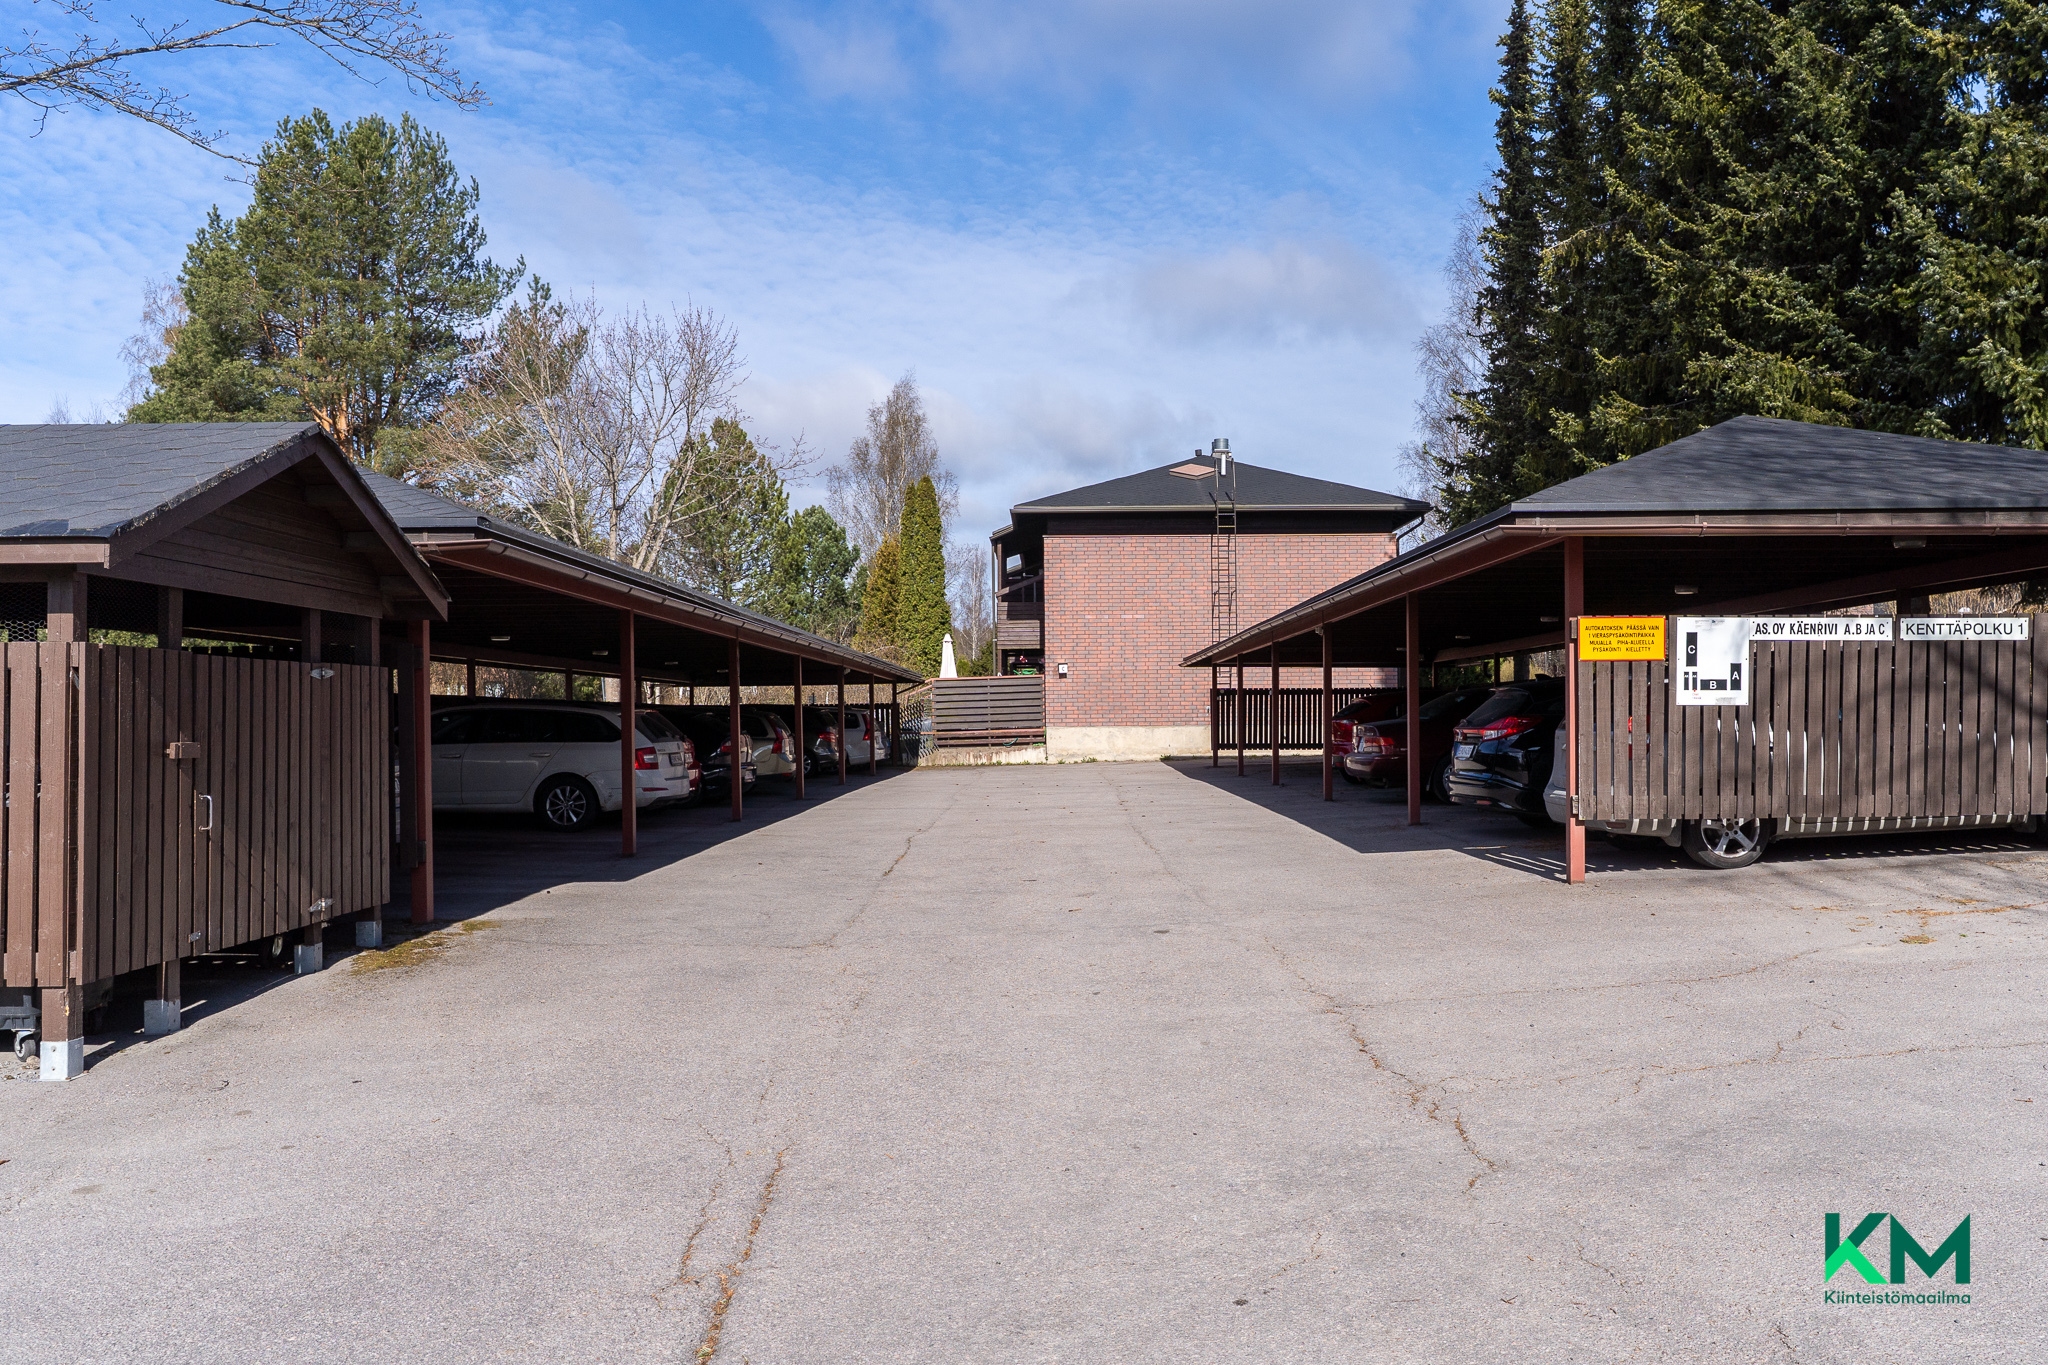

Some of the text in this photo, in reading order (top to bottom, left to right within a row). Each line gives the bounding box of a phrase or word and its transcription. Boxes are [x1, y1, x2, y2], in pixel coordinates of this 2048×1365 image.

[1789, 620, 1838, 635] KÄENRIVI
[1864, 623, 1876, 635] JA
[1878, 623, 1885, 635] C
[1905, 620, 2023, 635] KENTTÄPOLKU 1
[1687, 644, 1696, 655] C
[1731, 670, 1740, 680] A
[1709, 680, 1717, 690] B
